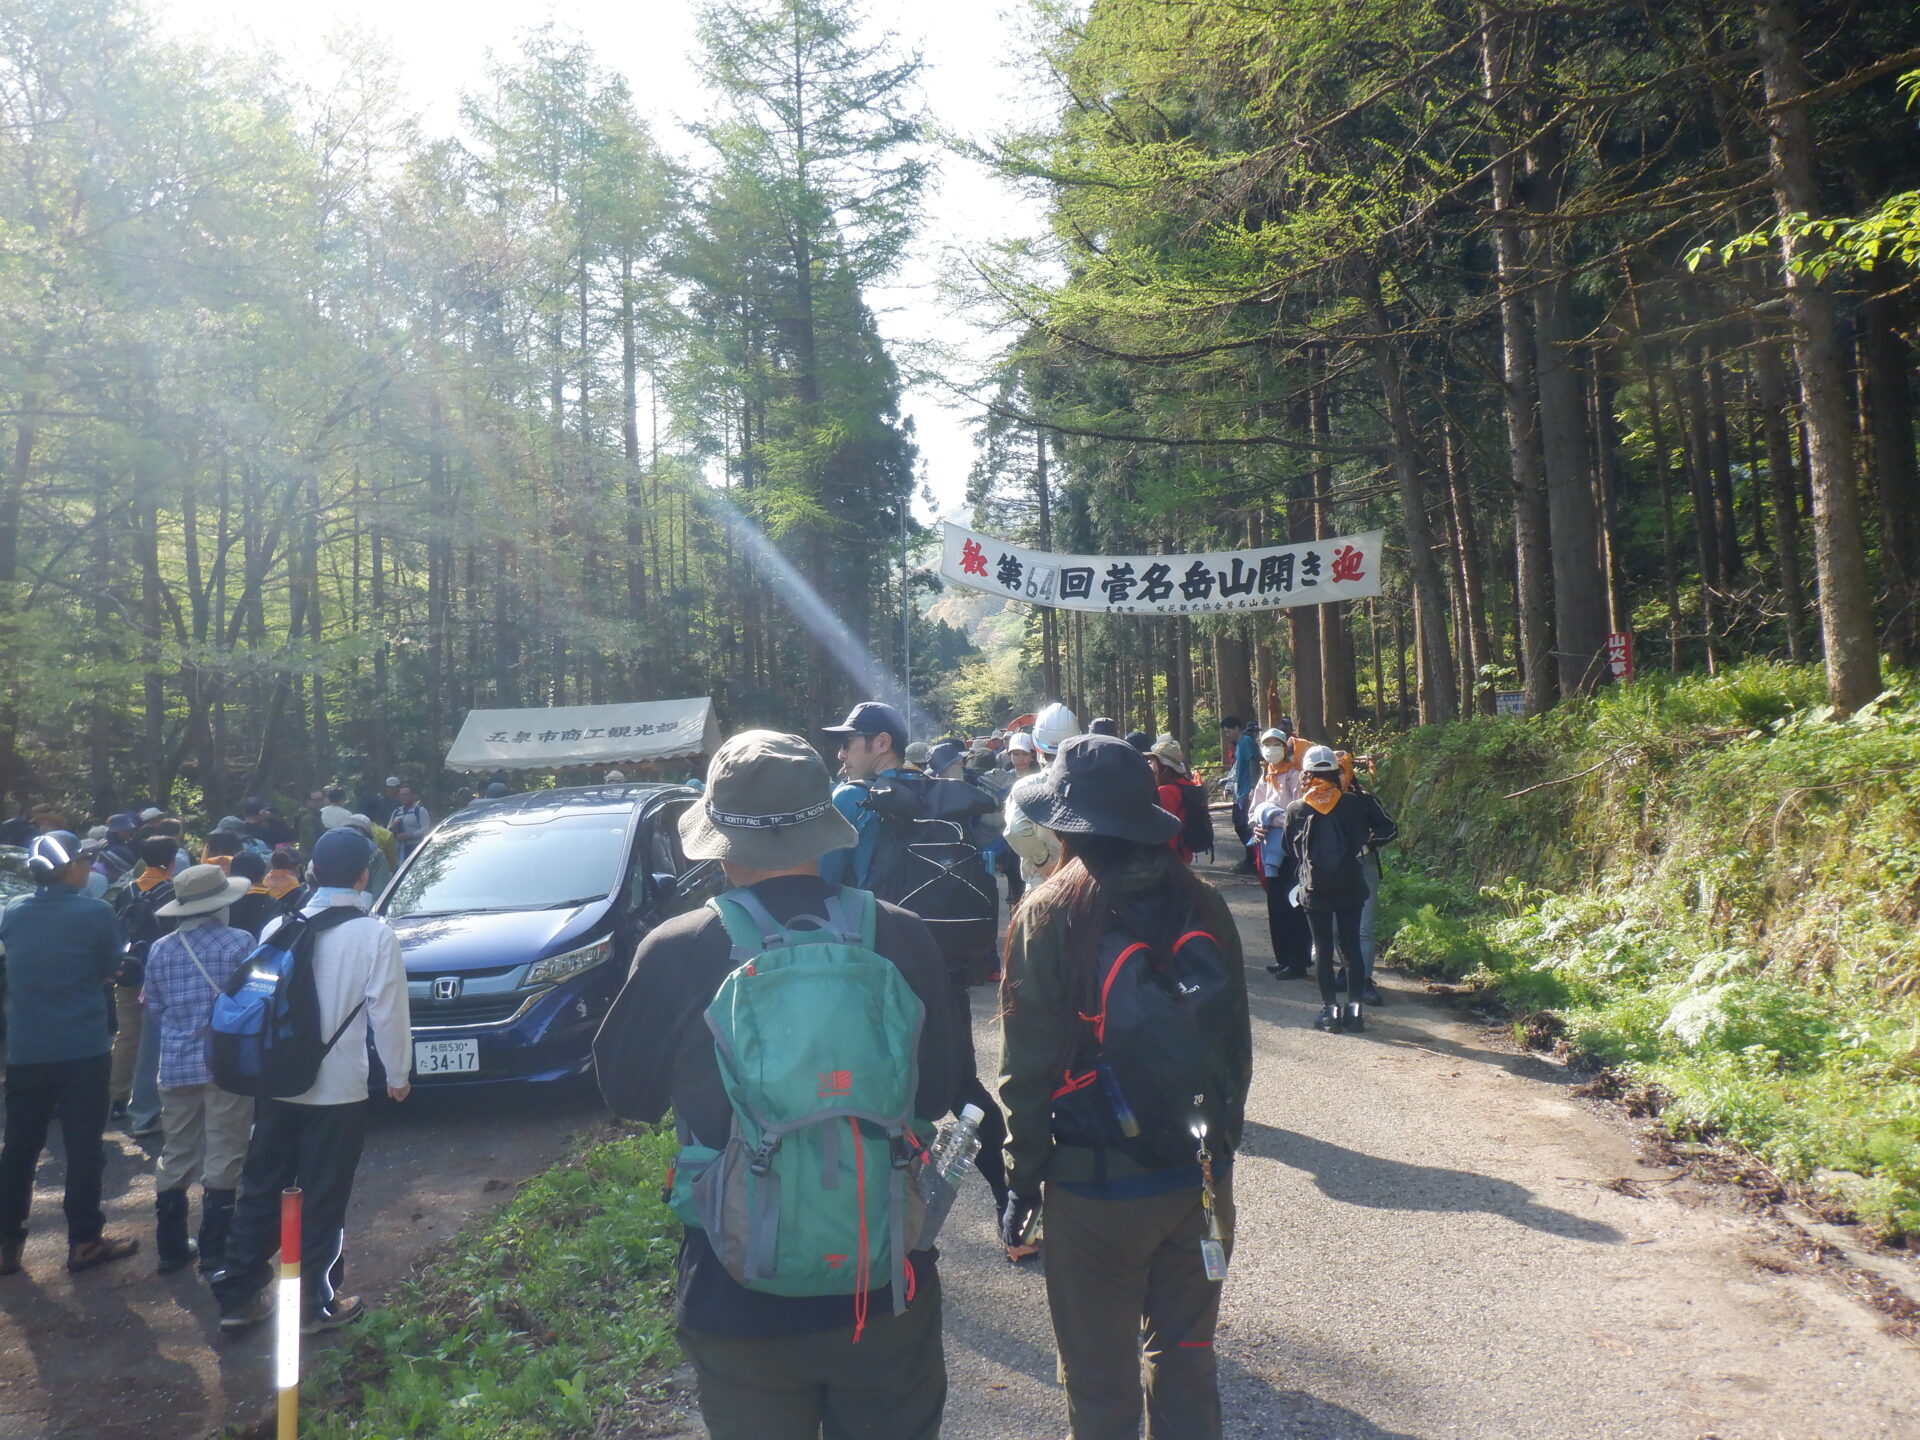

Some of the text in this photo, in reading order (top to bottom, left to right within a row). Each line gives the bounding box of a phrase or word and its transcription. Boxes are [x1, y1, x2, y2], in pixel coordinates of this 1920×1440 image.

[1331, 545, 1366, 584] 迎
[724, 815, 746, 824] NORTH
[430, 1053, 475, 1071] 34-17
